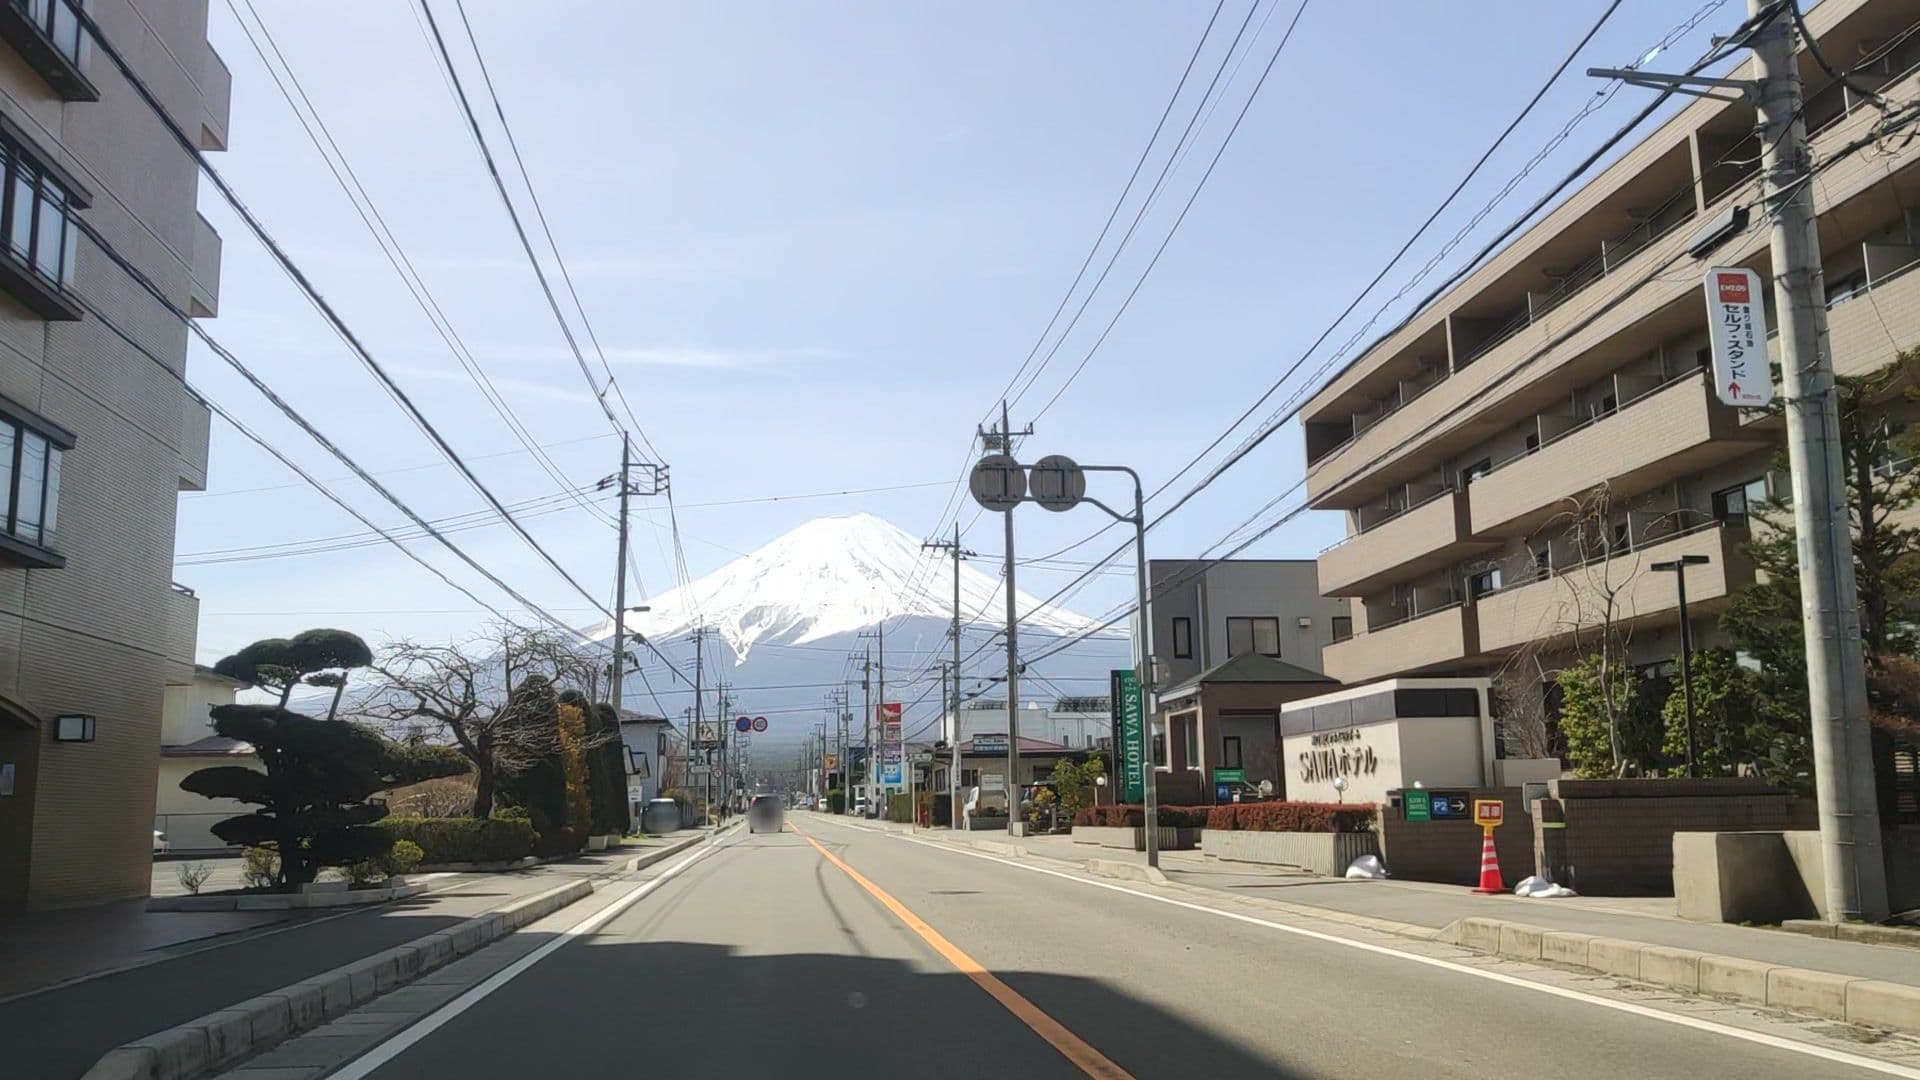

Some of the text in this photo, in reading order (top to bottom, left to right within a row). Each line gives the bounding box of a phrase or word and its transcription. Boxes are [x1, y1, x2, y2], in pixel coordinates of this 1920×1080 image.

[1722, 304, 1746, 380] セルフ・スタンド
[1124, 694, 1138, 737] SAWA
[1126, 740, 1141, 790] HOTEL
[1299, 745, 1378, 784] SAWAホテル
[1433, 801, 1448, 811] P2
